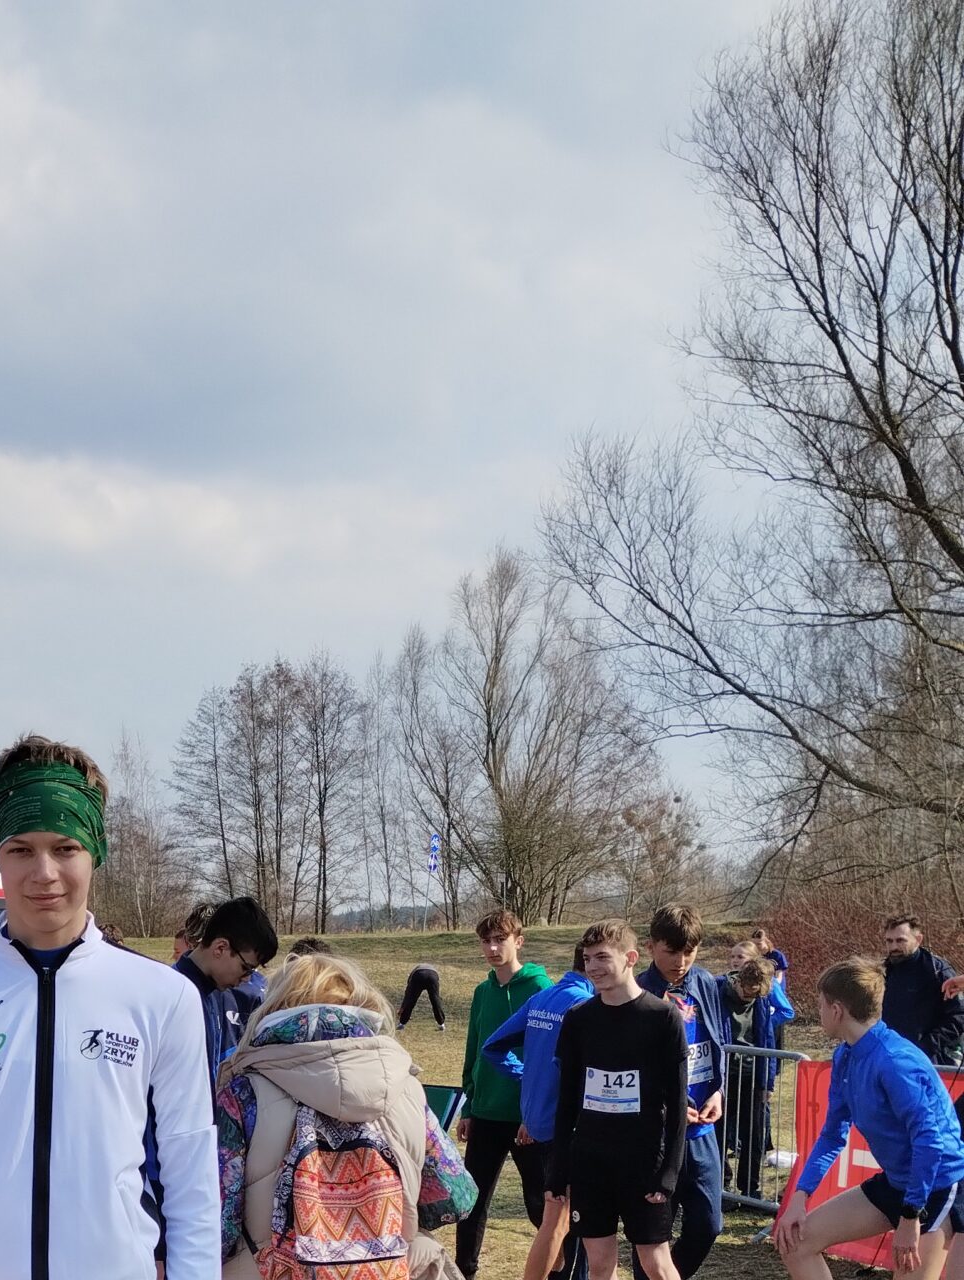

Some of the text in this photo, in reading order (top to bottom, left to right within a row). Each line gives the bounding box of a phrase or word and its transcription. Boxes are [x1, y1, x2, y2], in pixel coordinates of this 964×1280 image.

[105, 1031, 139, 1047] KLUB
[104, 1045, 136, 1062] ZRYW
[688, 1042, 711, 1061] 230
[603, 1072, 636, 1089] 142
